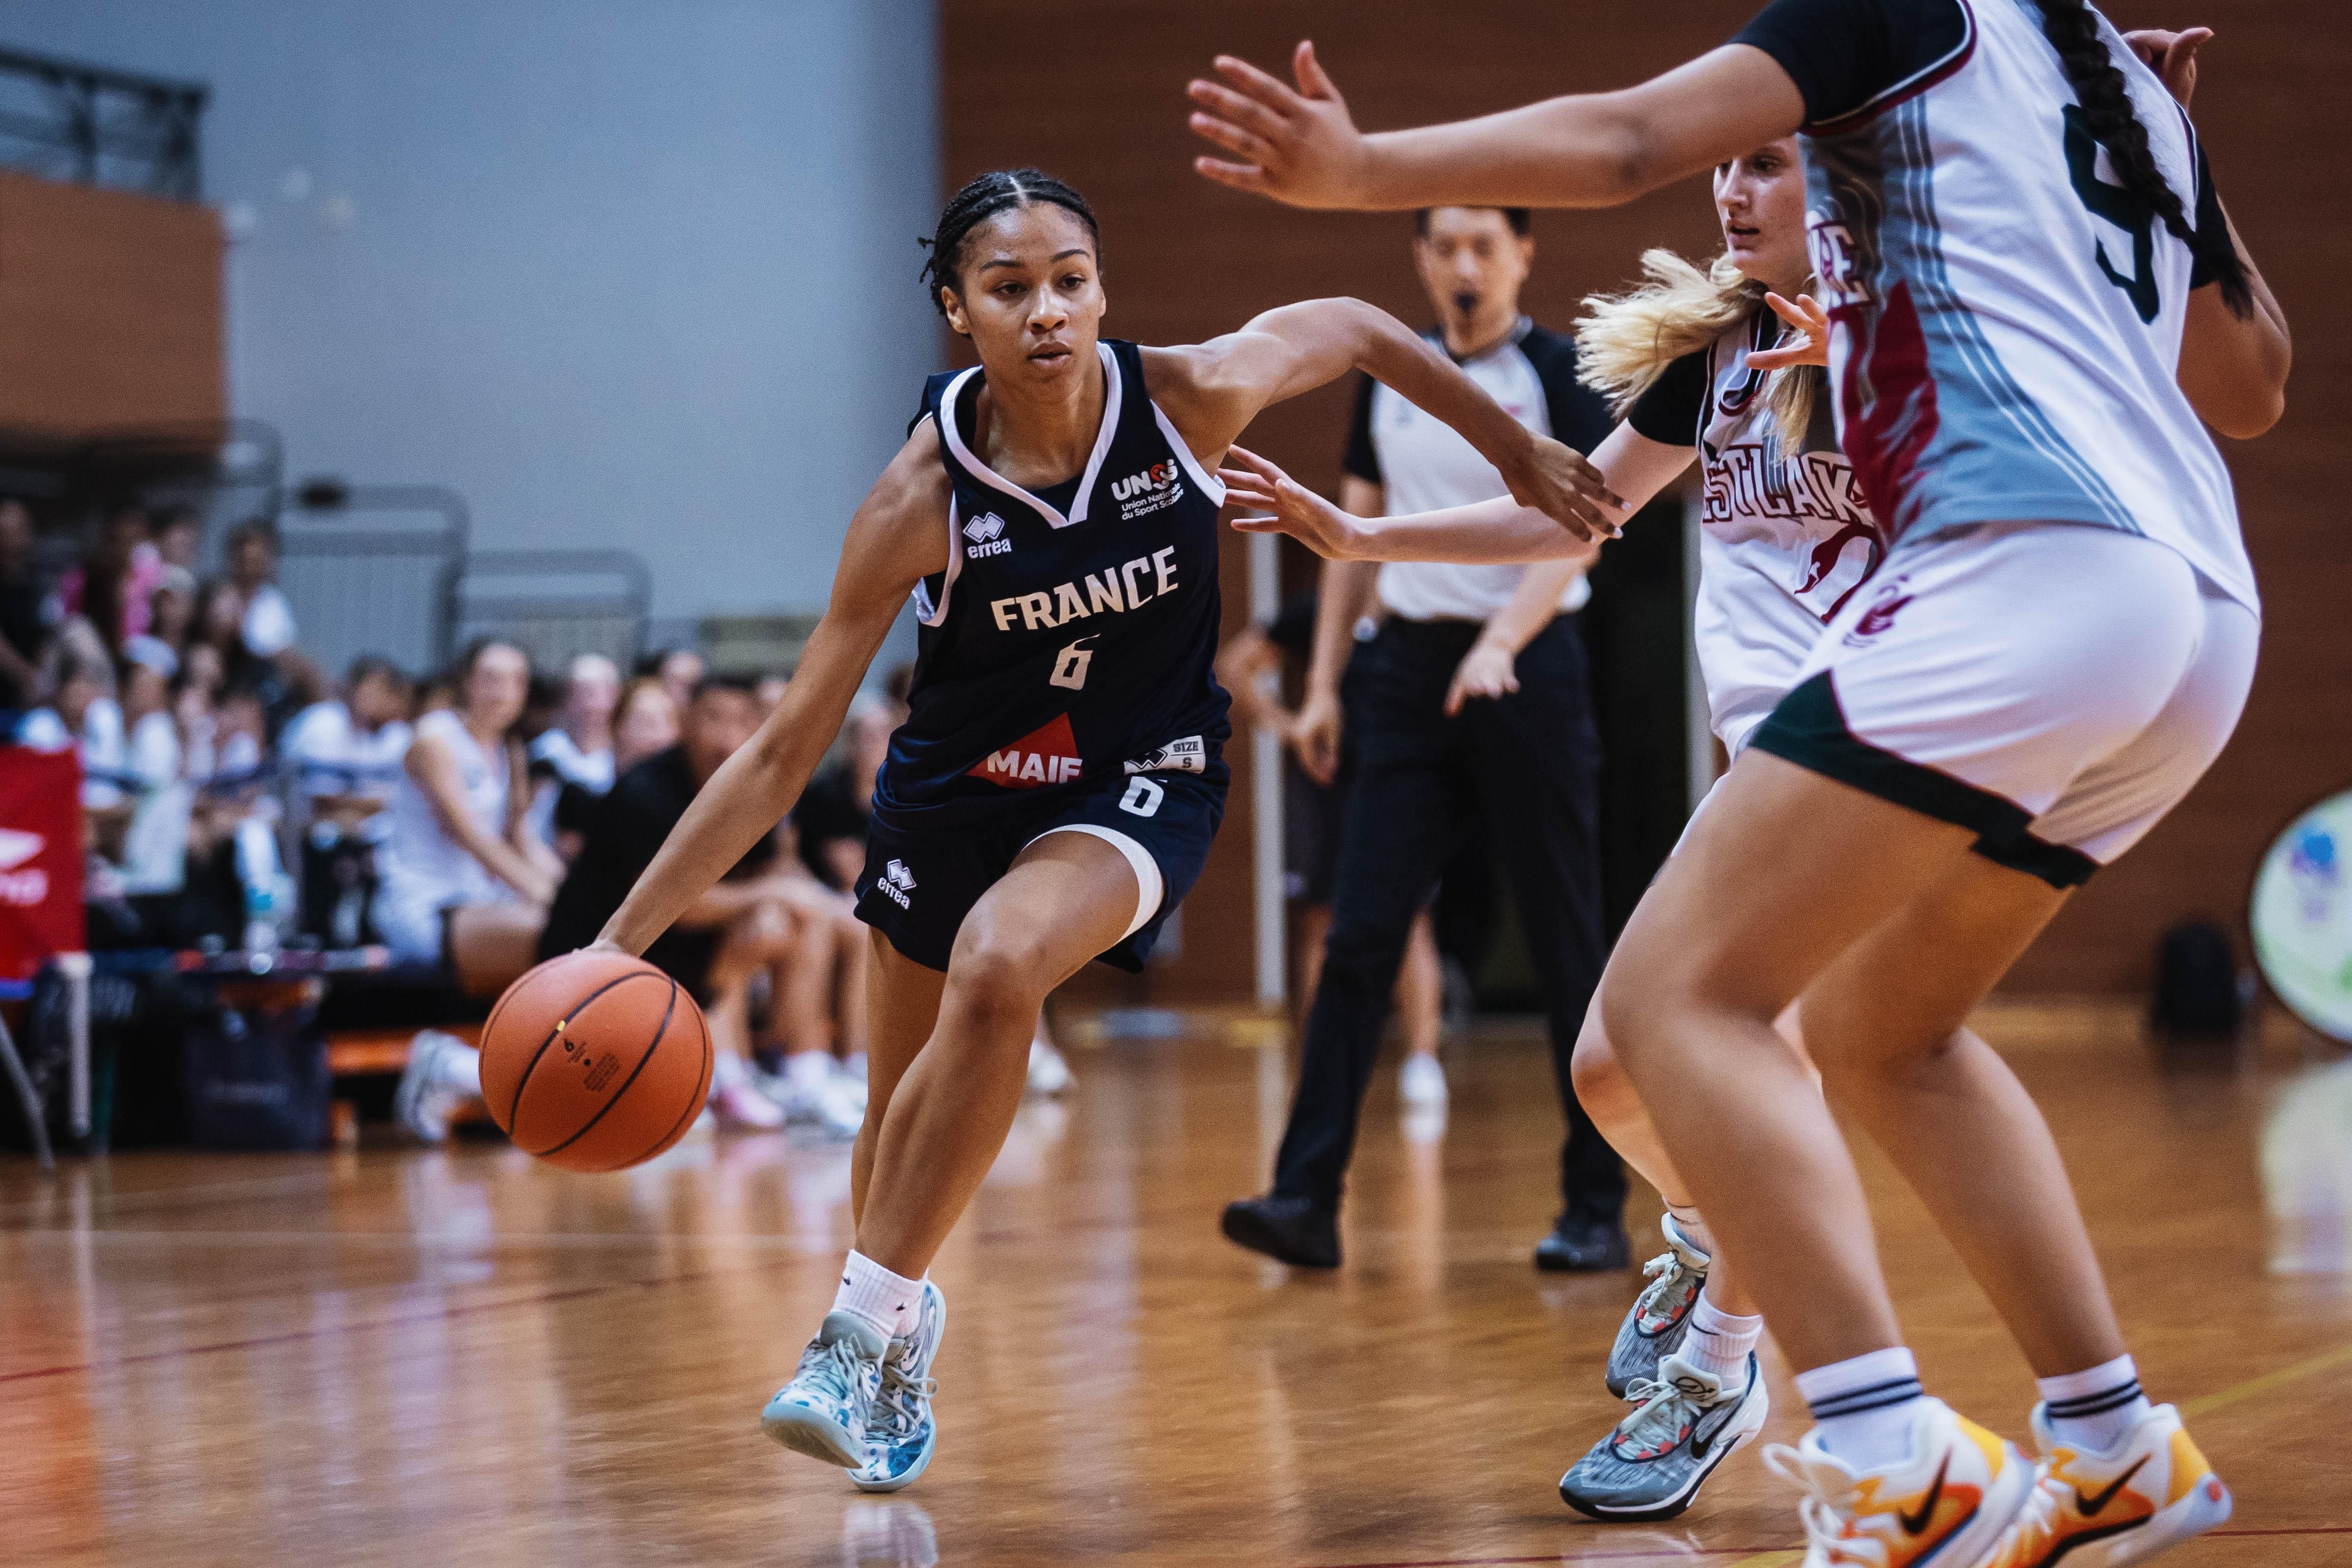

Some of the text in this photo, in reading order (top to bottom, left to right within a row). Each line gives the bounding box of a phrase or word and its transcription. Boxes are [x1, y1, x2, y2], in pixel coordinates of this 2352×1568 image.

[1702, 444, 1867, 523] STLAK
[1121, 498, 1147, 512] Union
[1121, 512, 1134, 520] du
[1134, 503, 1159, 516] Sport
[967, 537, 1012, 559] errea
[990, 545, 1179, 631] FRANCE
[1049, 633, 1102, 691] 6
[1173, 741, 1199, 753] SIZE
[986, 750, 1083, 784] MAIF
[1182, 756, 1192, 769] S
[877, 877, 911, 910] errea
